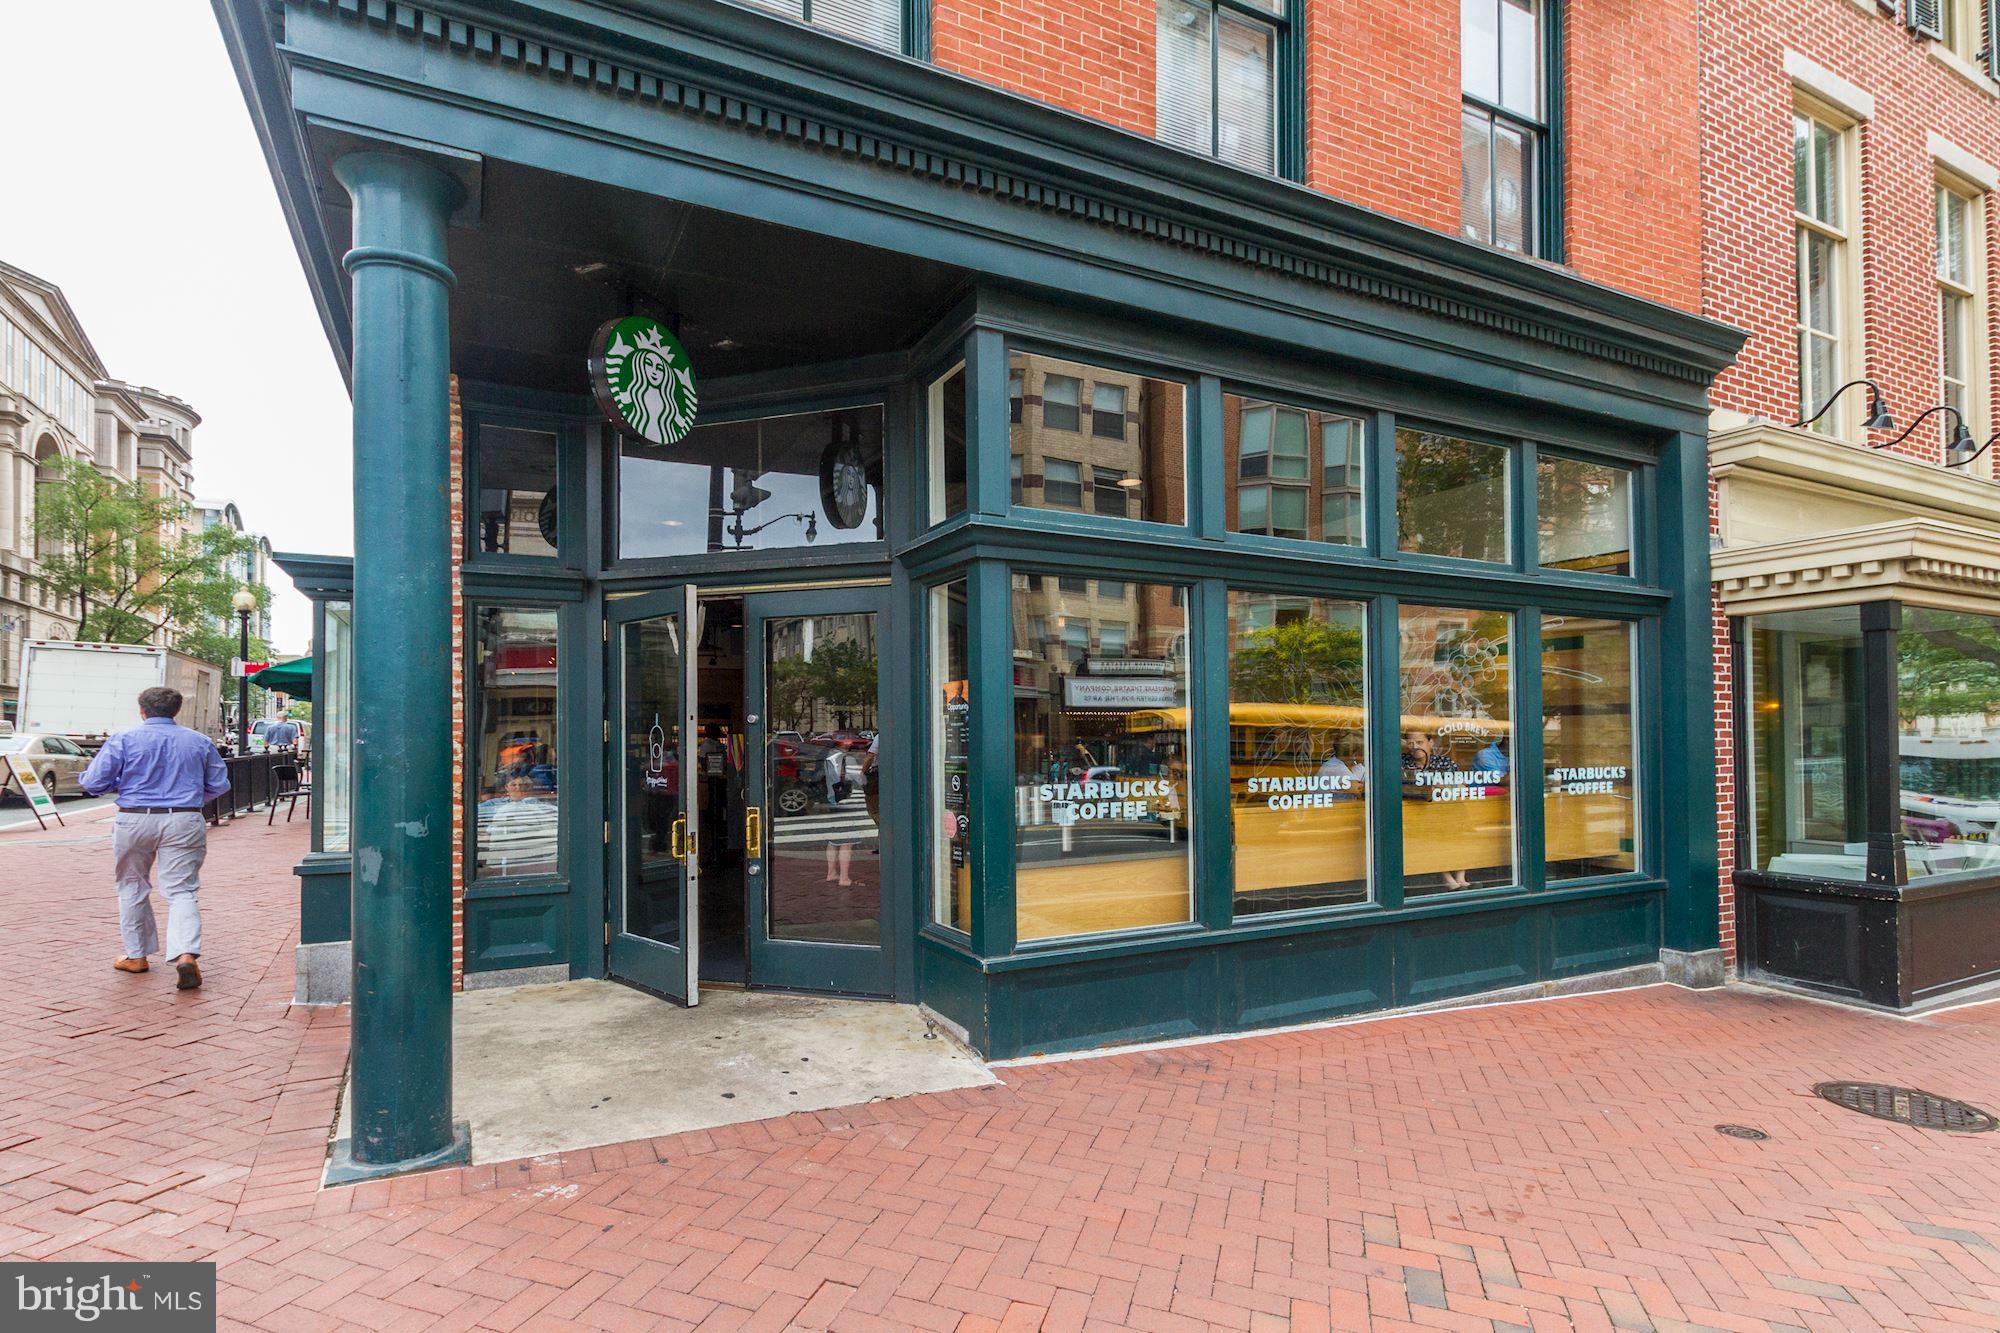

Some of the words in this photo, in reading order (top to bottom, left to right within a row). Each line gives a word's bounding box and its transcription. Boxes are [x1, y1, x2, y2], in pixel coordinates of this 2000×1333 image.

[1437, 723, 1463, 737] COLD
[1464, 722, 1489, 737] BREW
[1415, 770, 1501, 787] STARBUCKS
[1553, 767, 1626, 781] STARBUCKS
[1040, 780, 1170, 802] STARBUCKS
[1248, 775, 1351, 793] STARBUCKS
[1567, 781, 1614, 795] COFFEE
[1268, 794, 1333, 810] COFFEE
[1432, 786, 1486, 802] COFFEE
[1067, 801, 1148, 821] COFFEE
